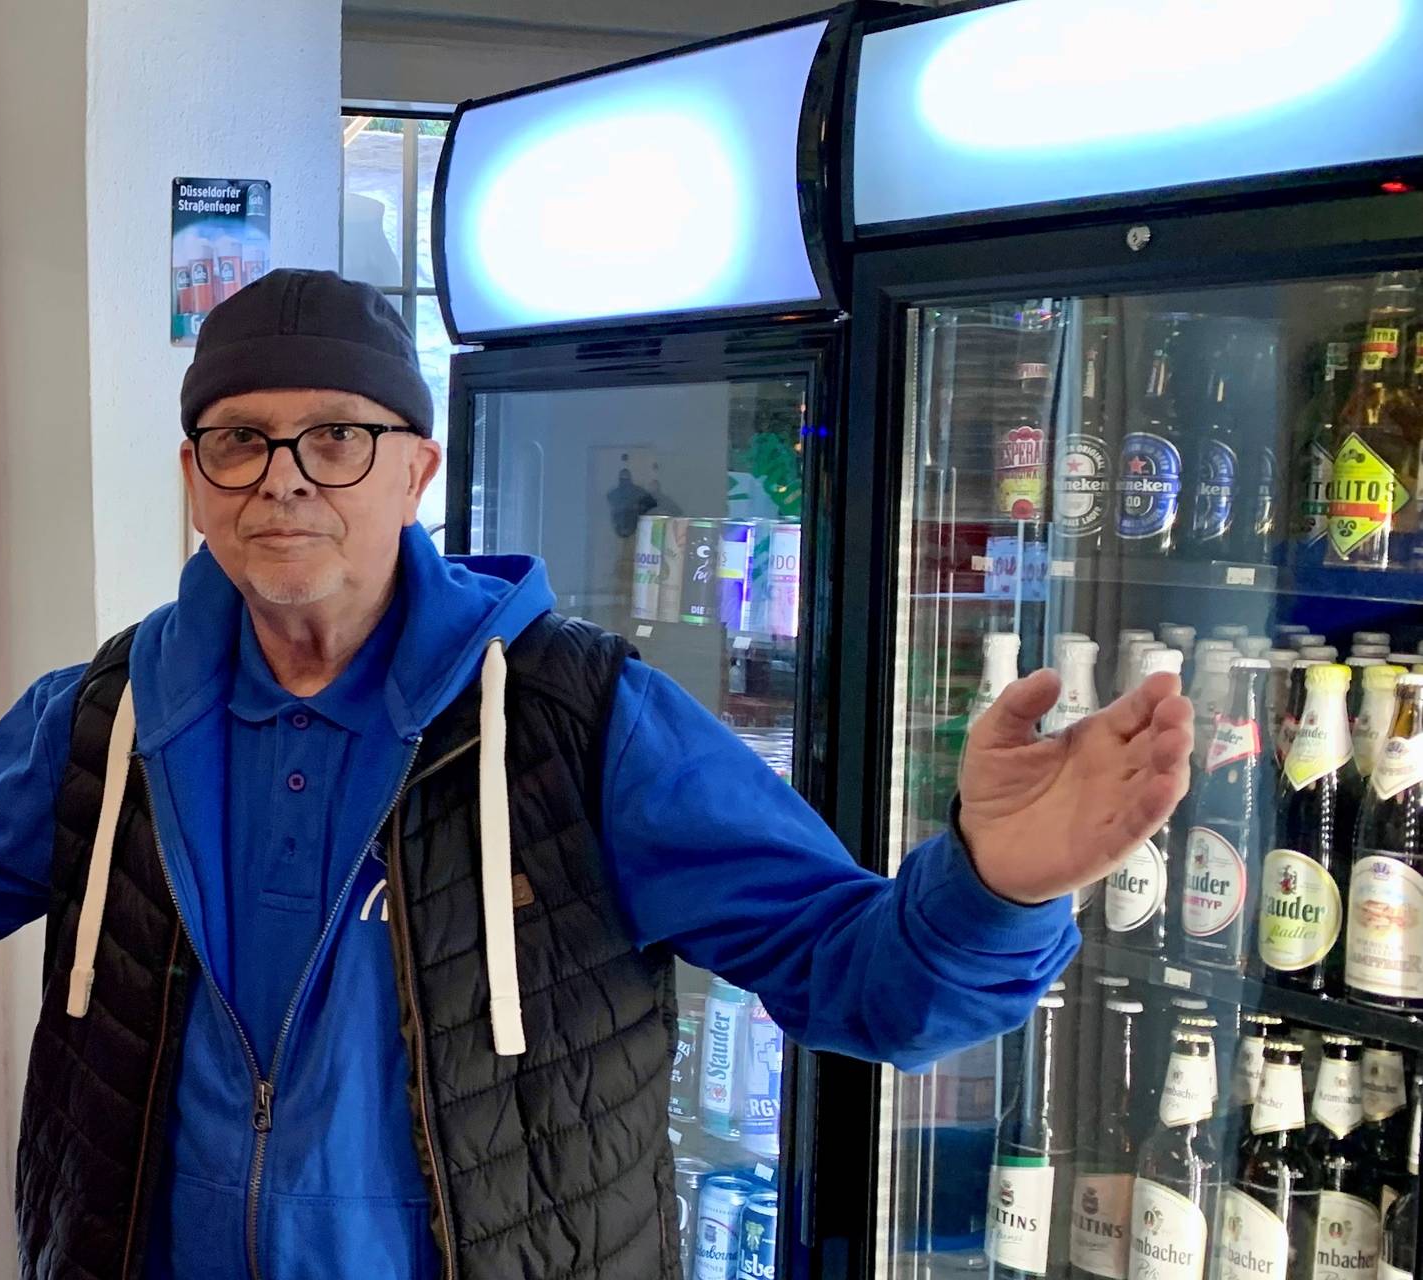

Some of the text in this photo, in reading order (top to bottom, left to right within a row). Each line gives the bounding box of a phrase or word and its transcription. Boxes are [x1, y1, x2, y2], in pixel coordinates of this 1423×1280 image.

[180, 185, 241, 199] Düsseldorfer
[178, 199, 241, 214] Straßenfeger
[1265, 895, 1326, 924] auder
[706, 1011, 731, 1081] Stauder
